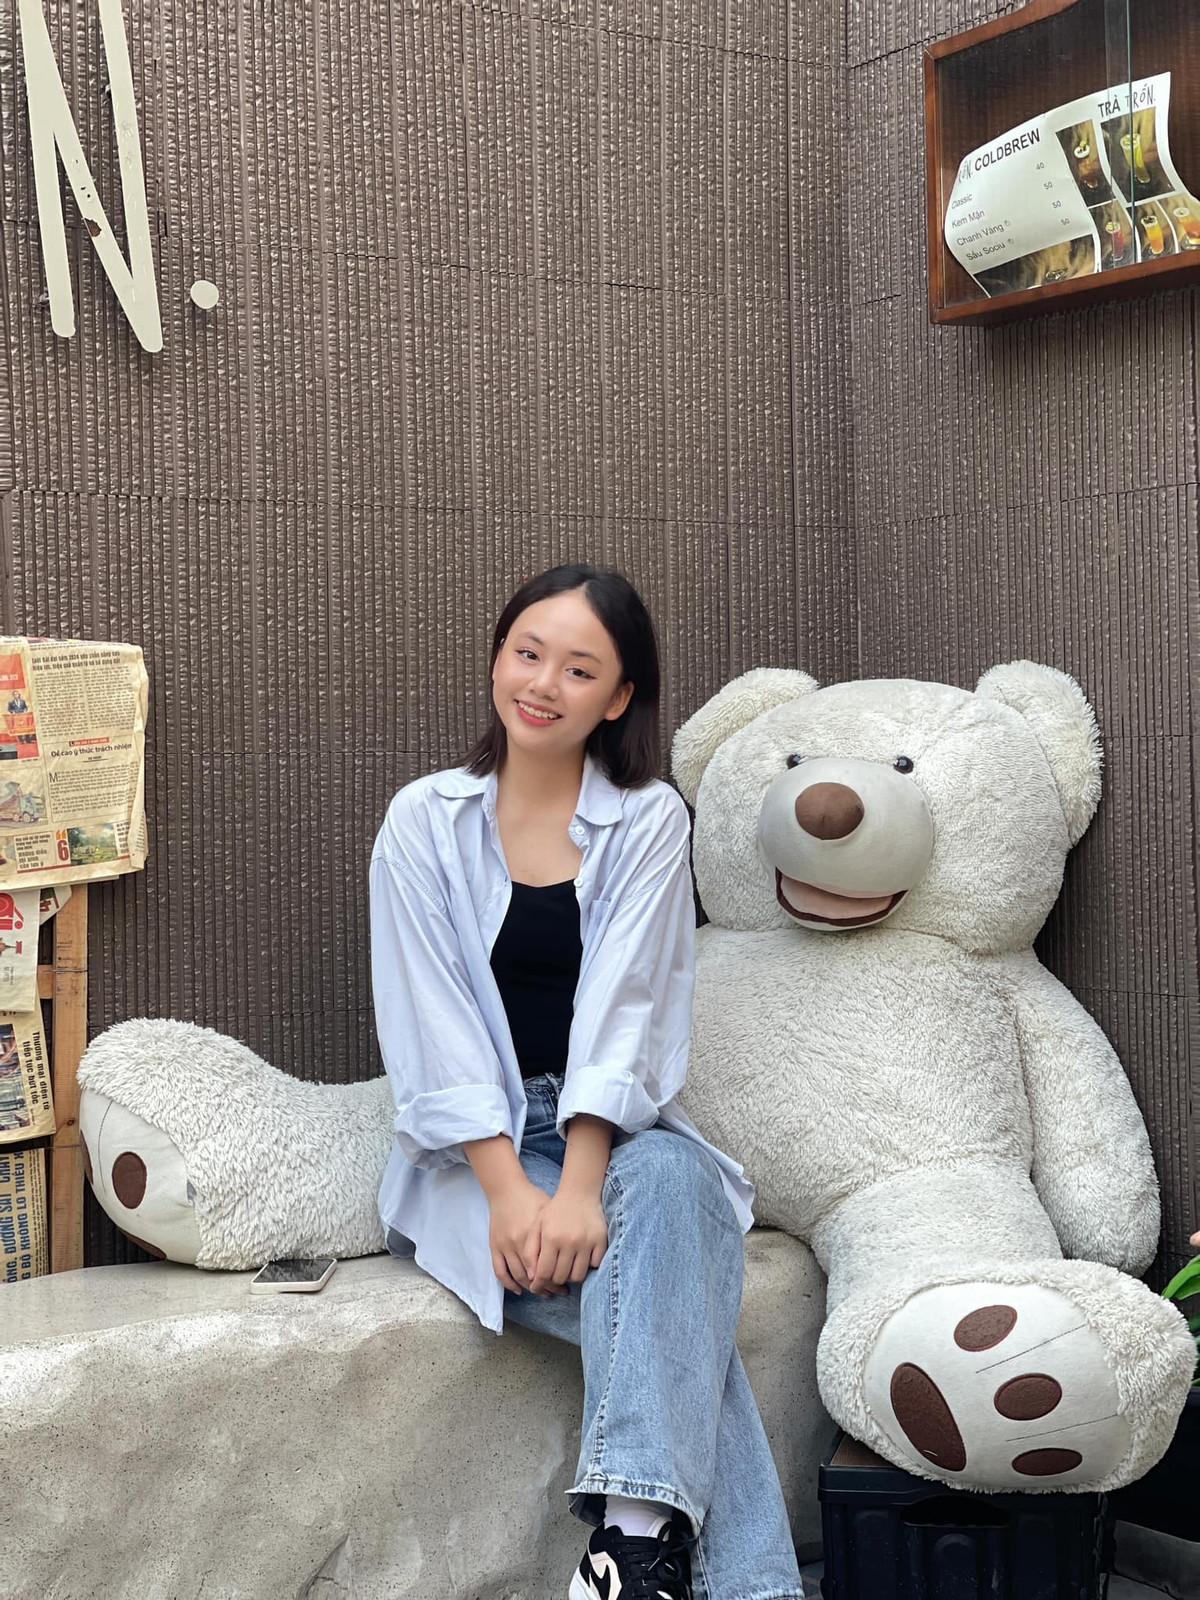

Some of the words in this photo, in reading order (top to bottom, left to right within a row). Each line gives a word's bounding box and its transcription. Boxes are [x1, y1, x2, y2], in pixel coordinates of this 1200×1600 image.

[1098, 94, 1121, 118] TRÀ
[974, 128, 1041, 171] COLDBREW
[1036, 161, 1045, 170] 40
[951, 216, 968, 229] Kem
[968, 209, 985, 222] Mận
[1043, 181, 1053, 190] 50
[956, 230, 983, 246] Chanh
[982, 223, 1005, 237] Vàng
[1052, 200, 1062, 209] 50
[1060, 218, 1071, 226] 50
[79, 746, 94, 755] thức
[95, 744, 113, 753] trách
[57, 839, 69, 861] 6
[32, 1031, 42, 1061] Thương
[36, 1063, 45, 1079] mại
[39, 1079, 48, 1099] điện
[12, 1163, 26, 1194] THIẾU
[16, 1196, 27, 1211] LO
[17, 1213, 31, 1251] KHÔNG
[20, 1253, 33, 1269] BỘ
